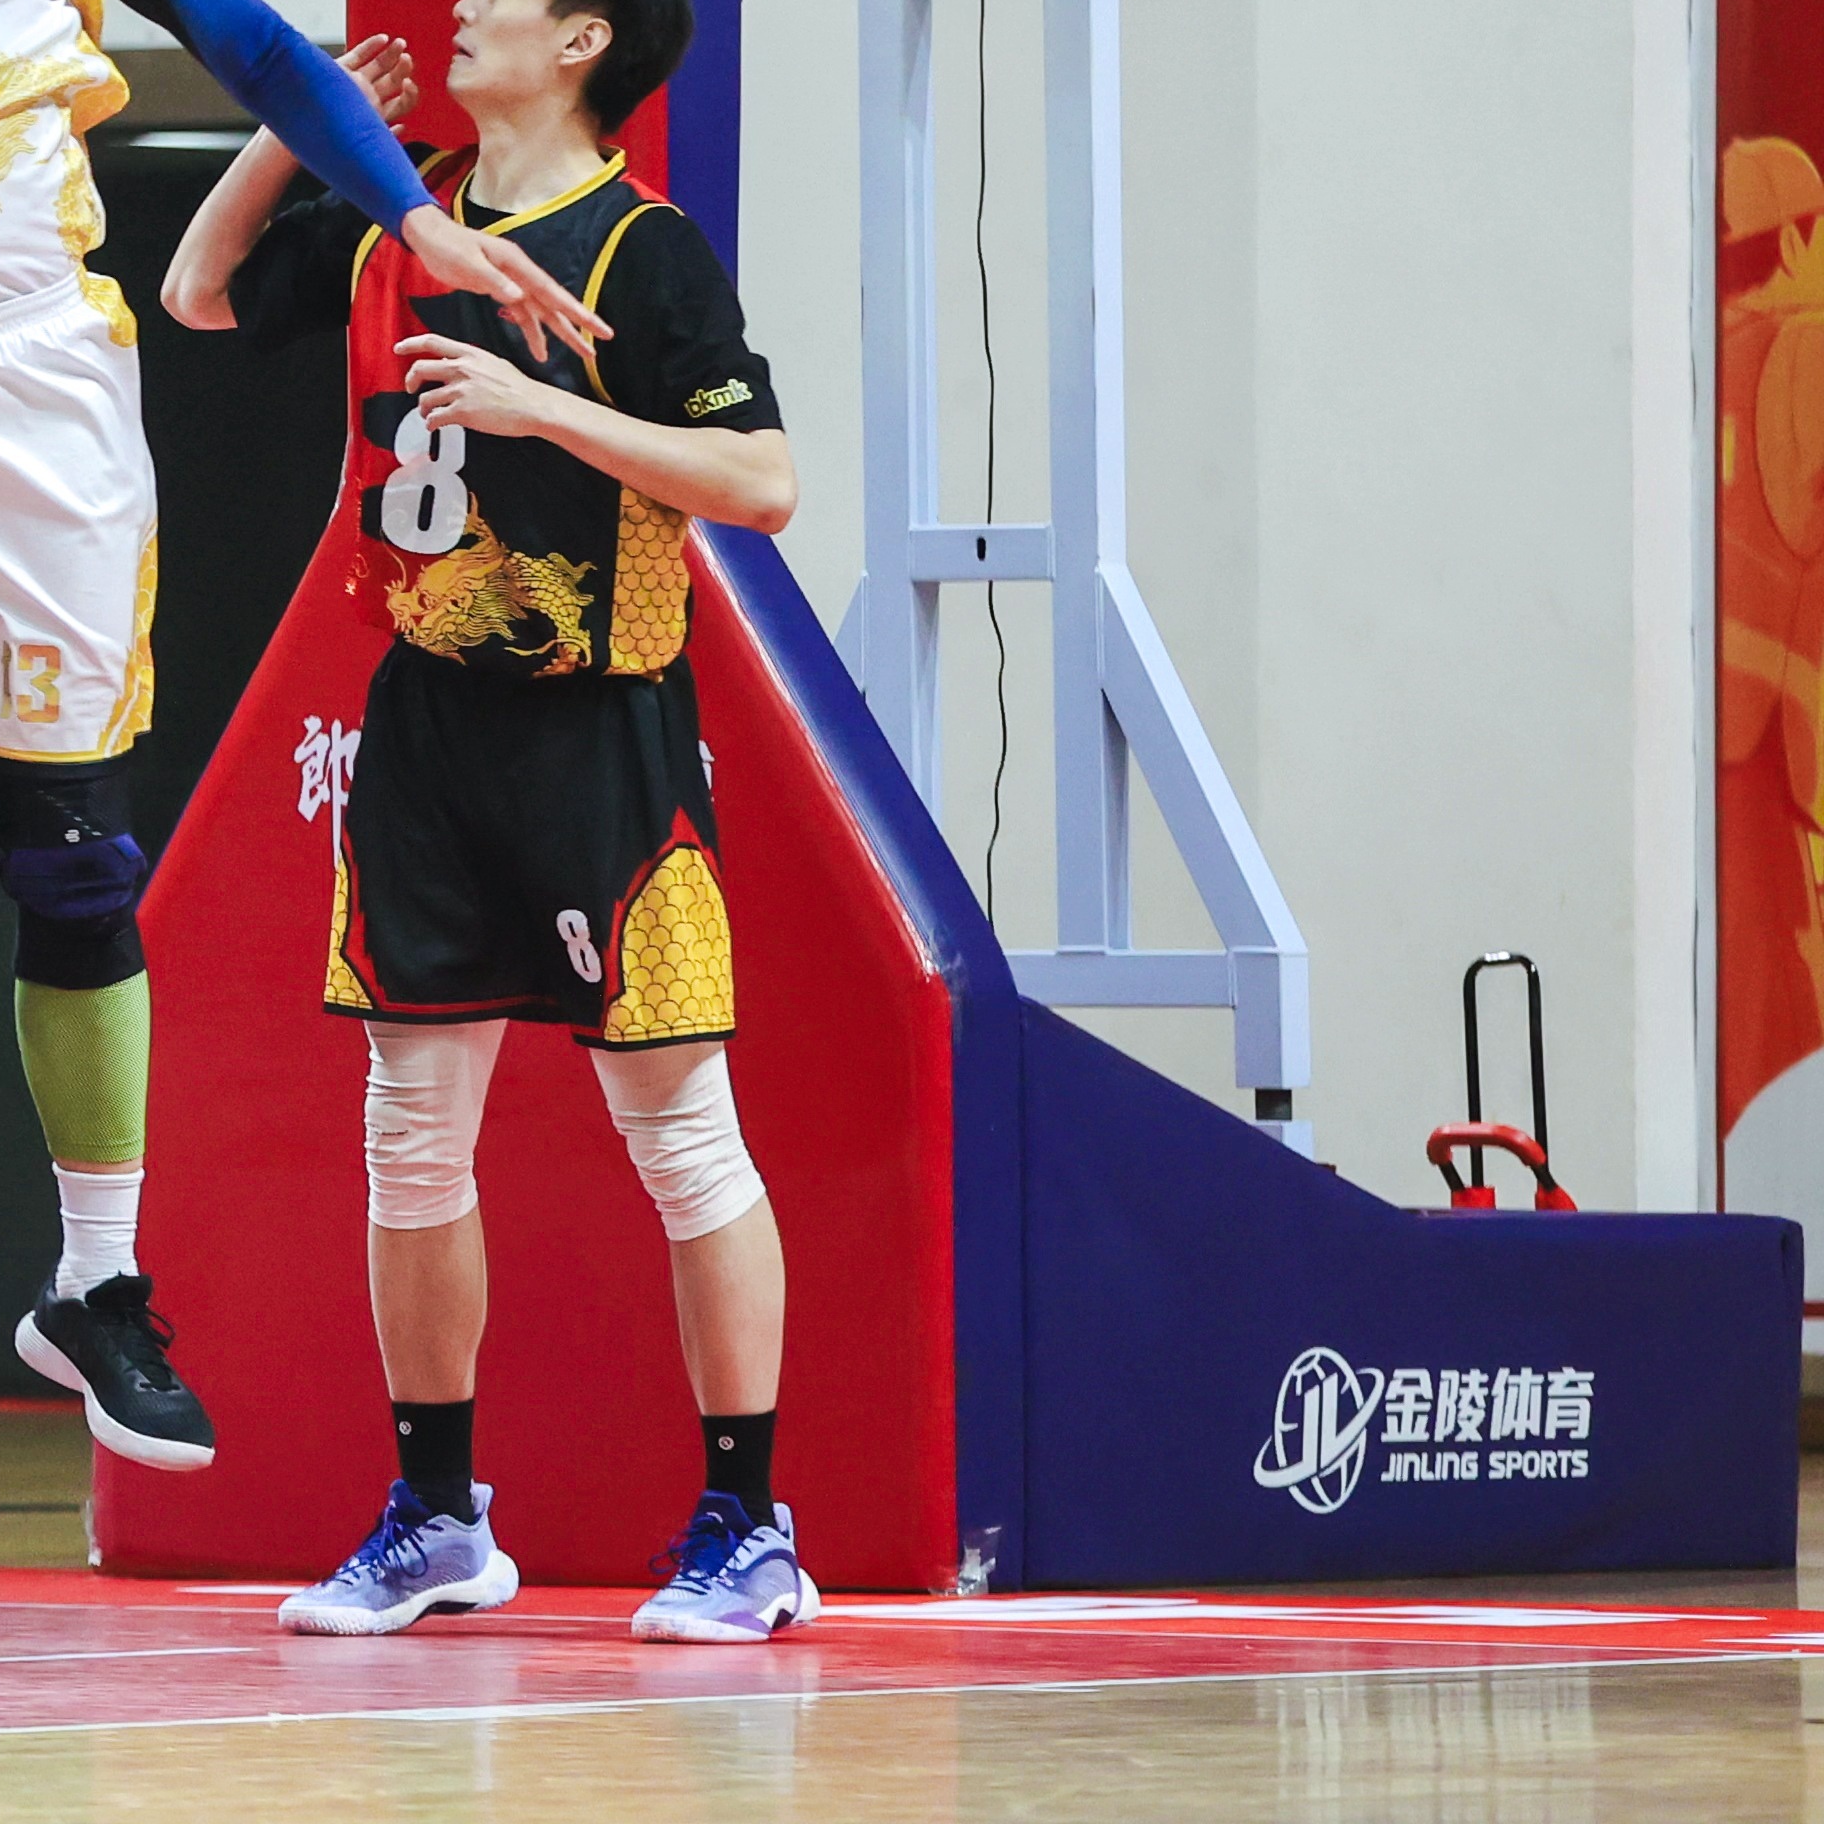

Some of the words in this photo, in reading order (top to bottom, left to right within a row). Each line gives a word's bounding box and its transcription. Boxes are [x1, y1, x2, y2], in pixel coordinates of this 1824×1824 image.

[381, 405, 468, 555] 8
[556, 909, 603, 984] 8
[1381, 1367, 1595, 1443] 金陵体育
[1488, 1449, 1589, 1479] SPORTS
